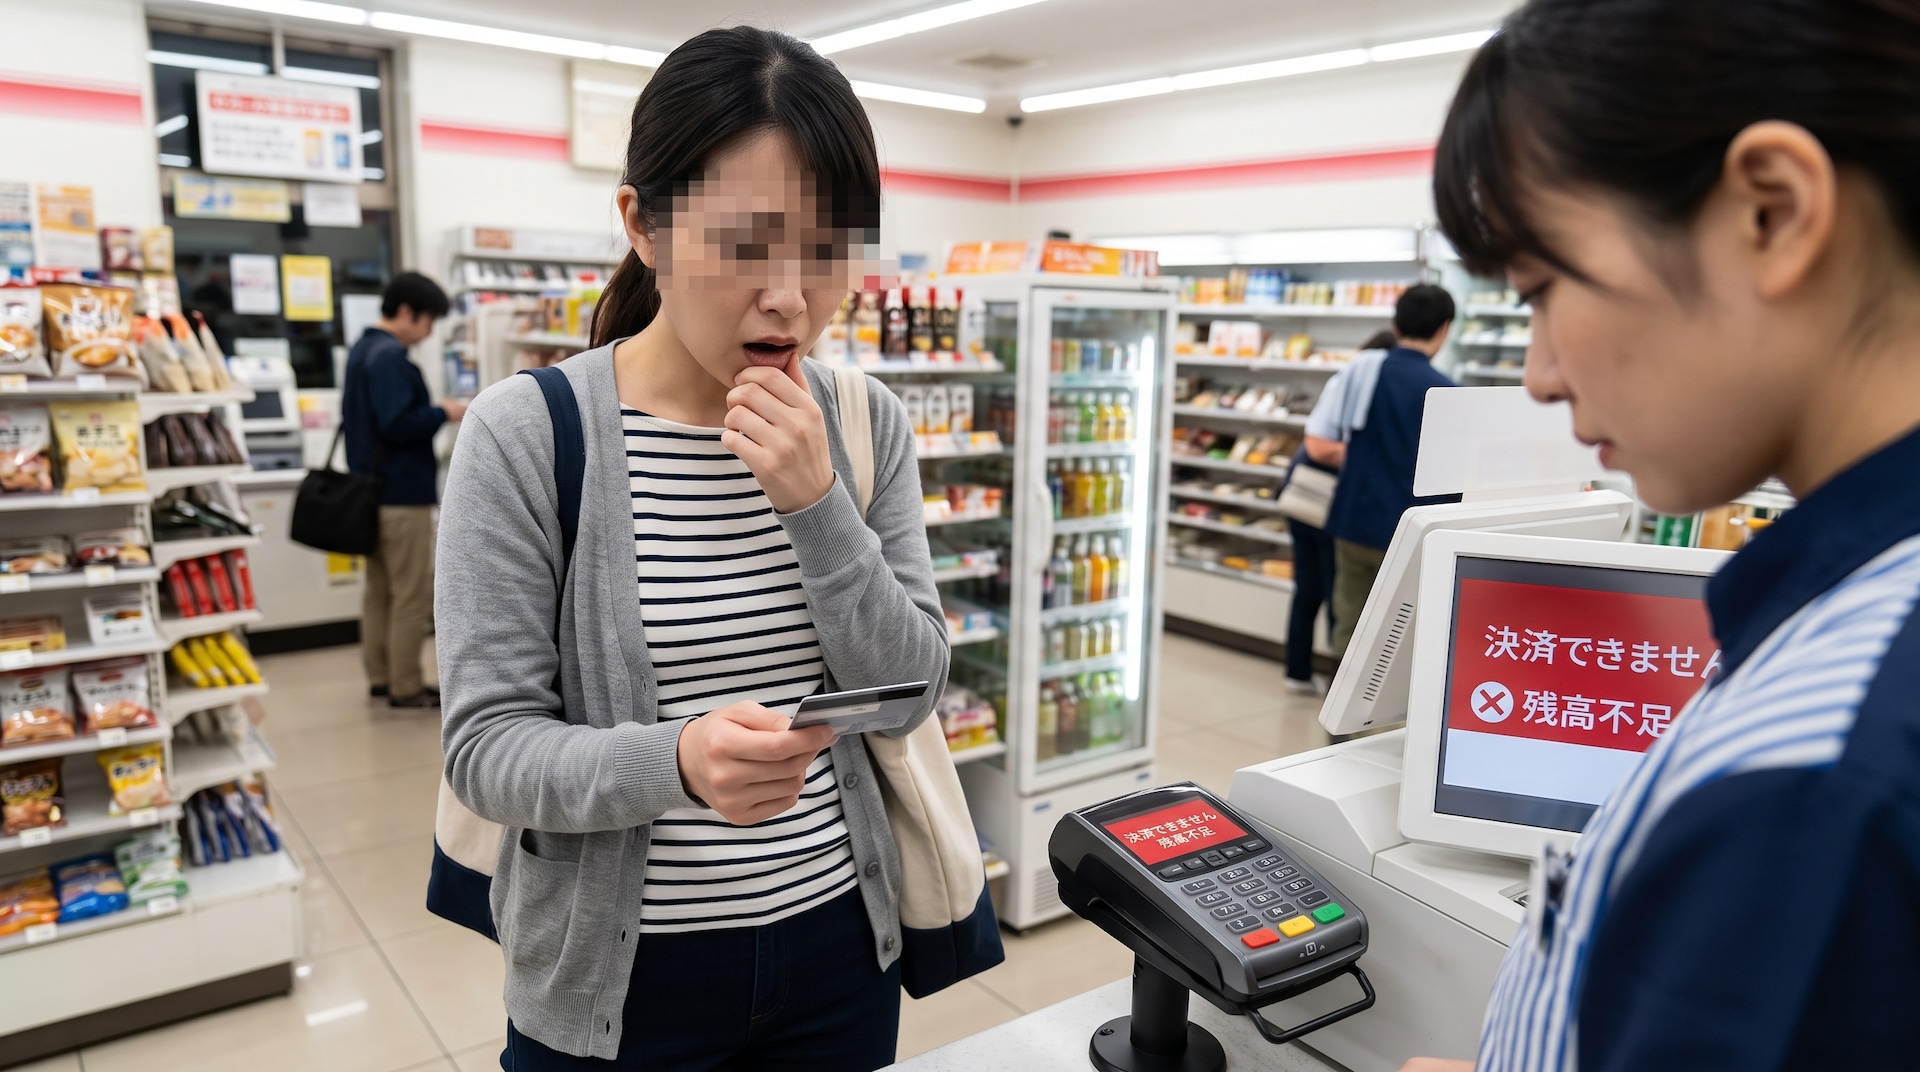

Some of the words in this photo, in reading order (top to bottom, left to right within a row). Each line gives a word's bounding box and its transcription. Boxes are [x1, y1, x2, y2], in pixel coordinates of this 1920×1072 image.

[1521, 689, 1672, 738] 残高不足
[1123, 811, 1217, 844] 決済できません
[1156, 827, 1217, 849] 残高不足
